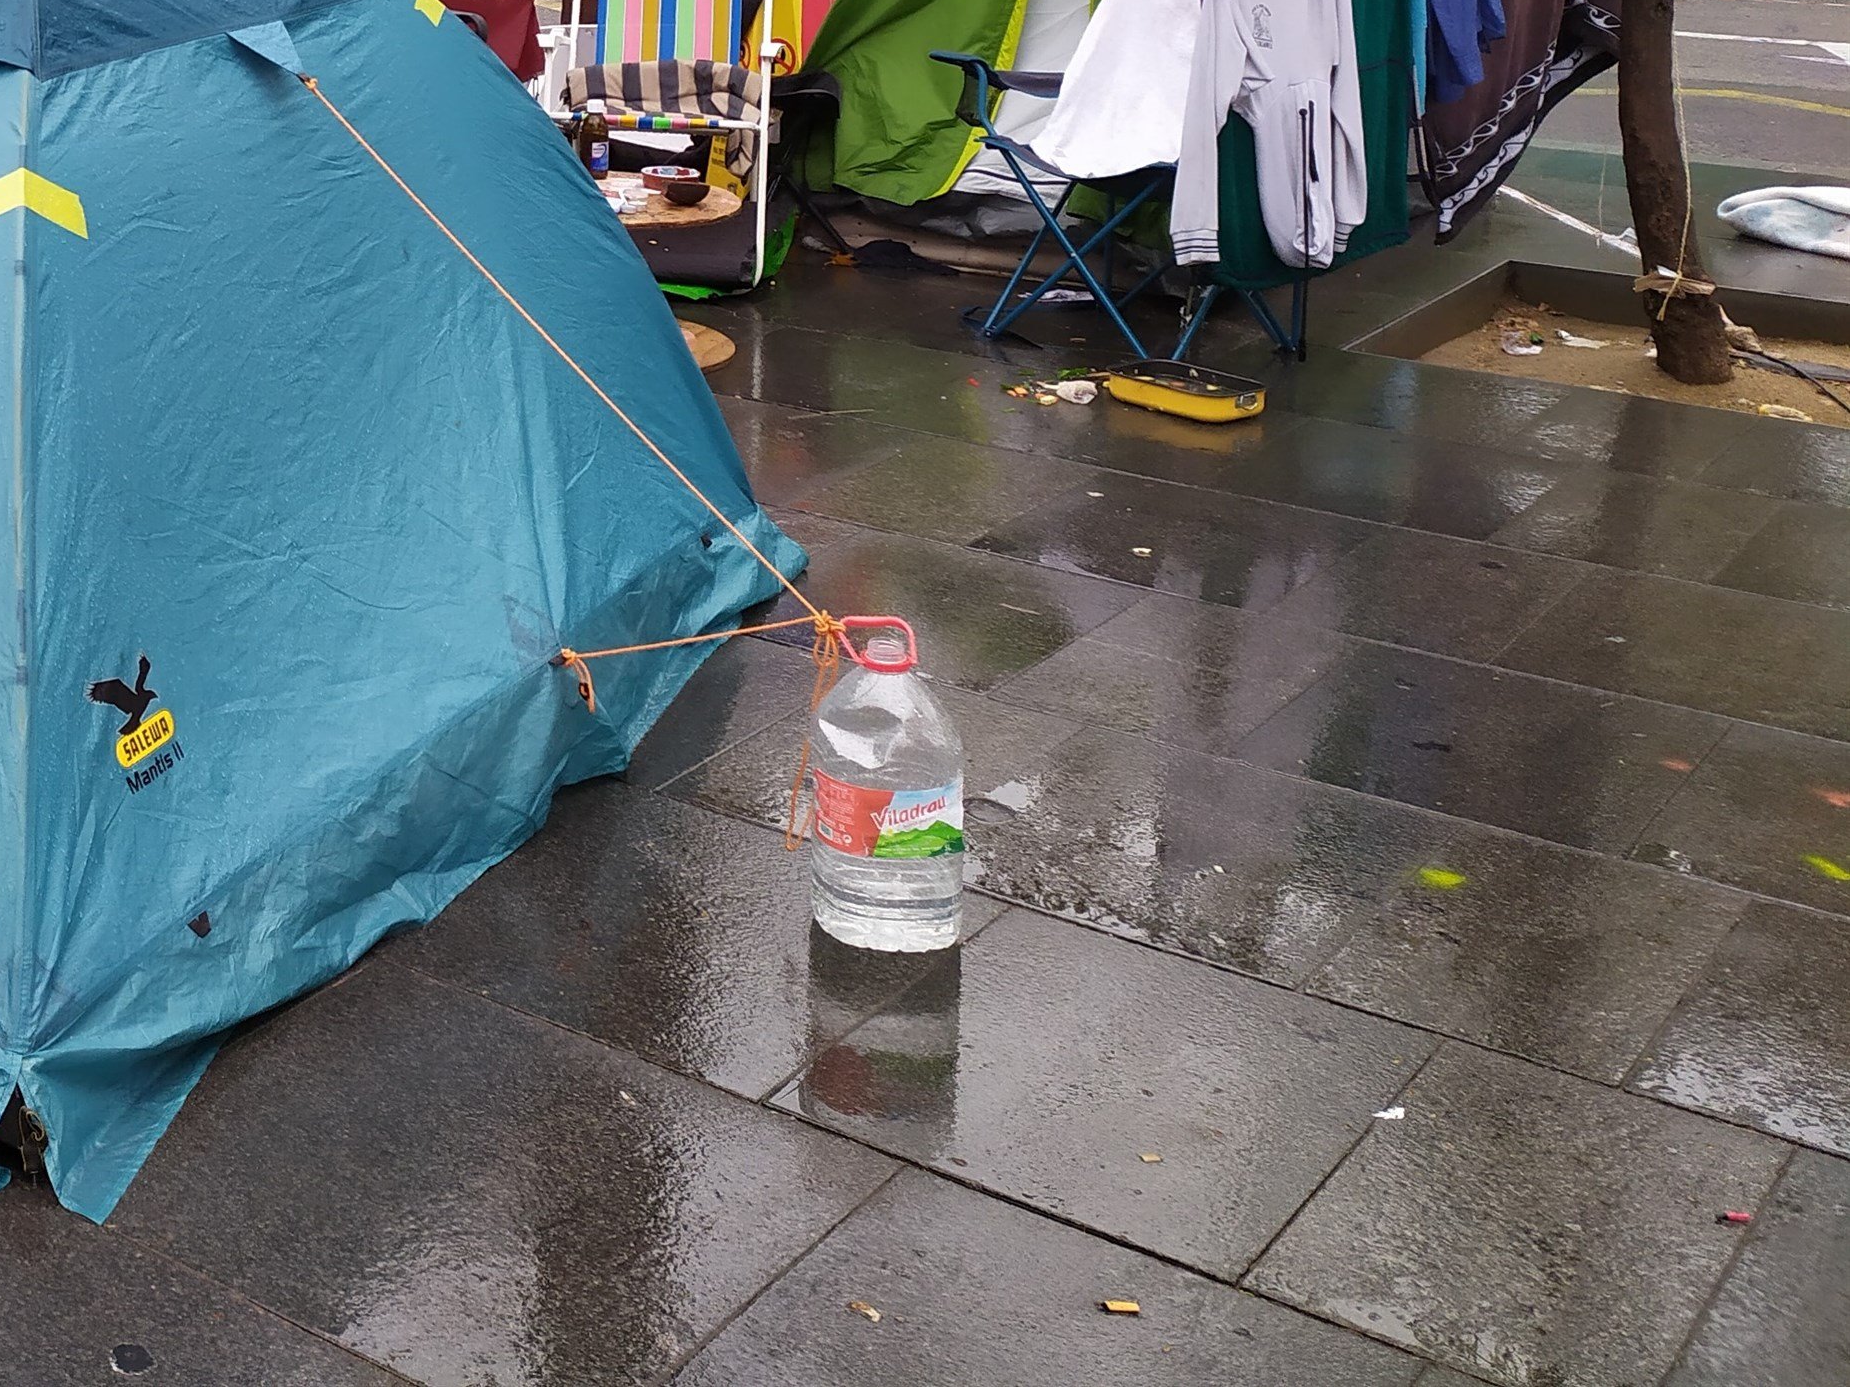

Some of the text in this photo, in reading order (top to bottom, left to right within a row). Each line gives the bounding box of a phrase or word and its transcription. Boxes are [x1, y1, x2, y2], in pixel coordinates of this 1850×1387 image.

[123, 716, 170, 761] SALEWA
[125, 741, 185, 795] Mantis II
[870, 796, 947, 829] Viladrau
